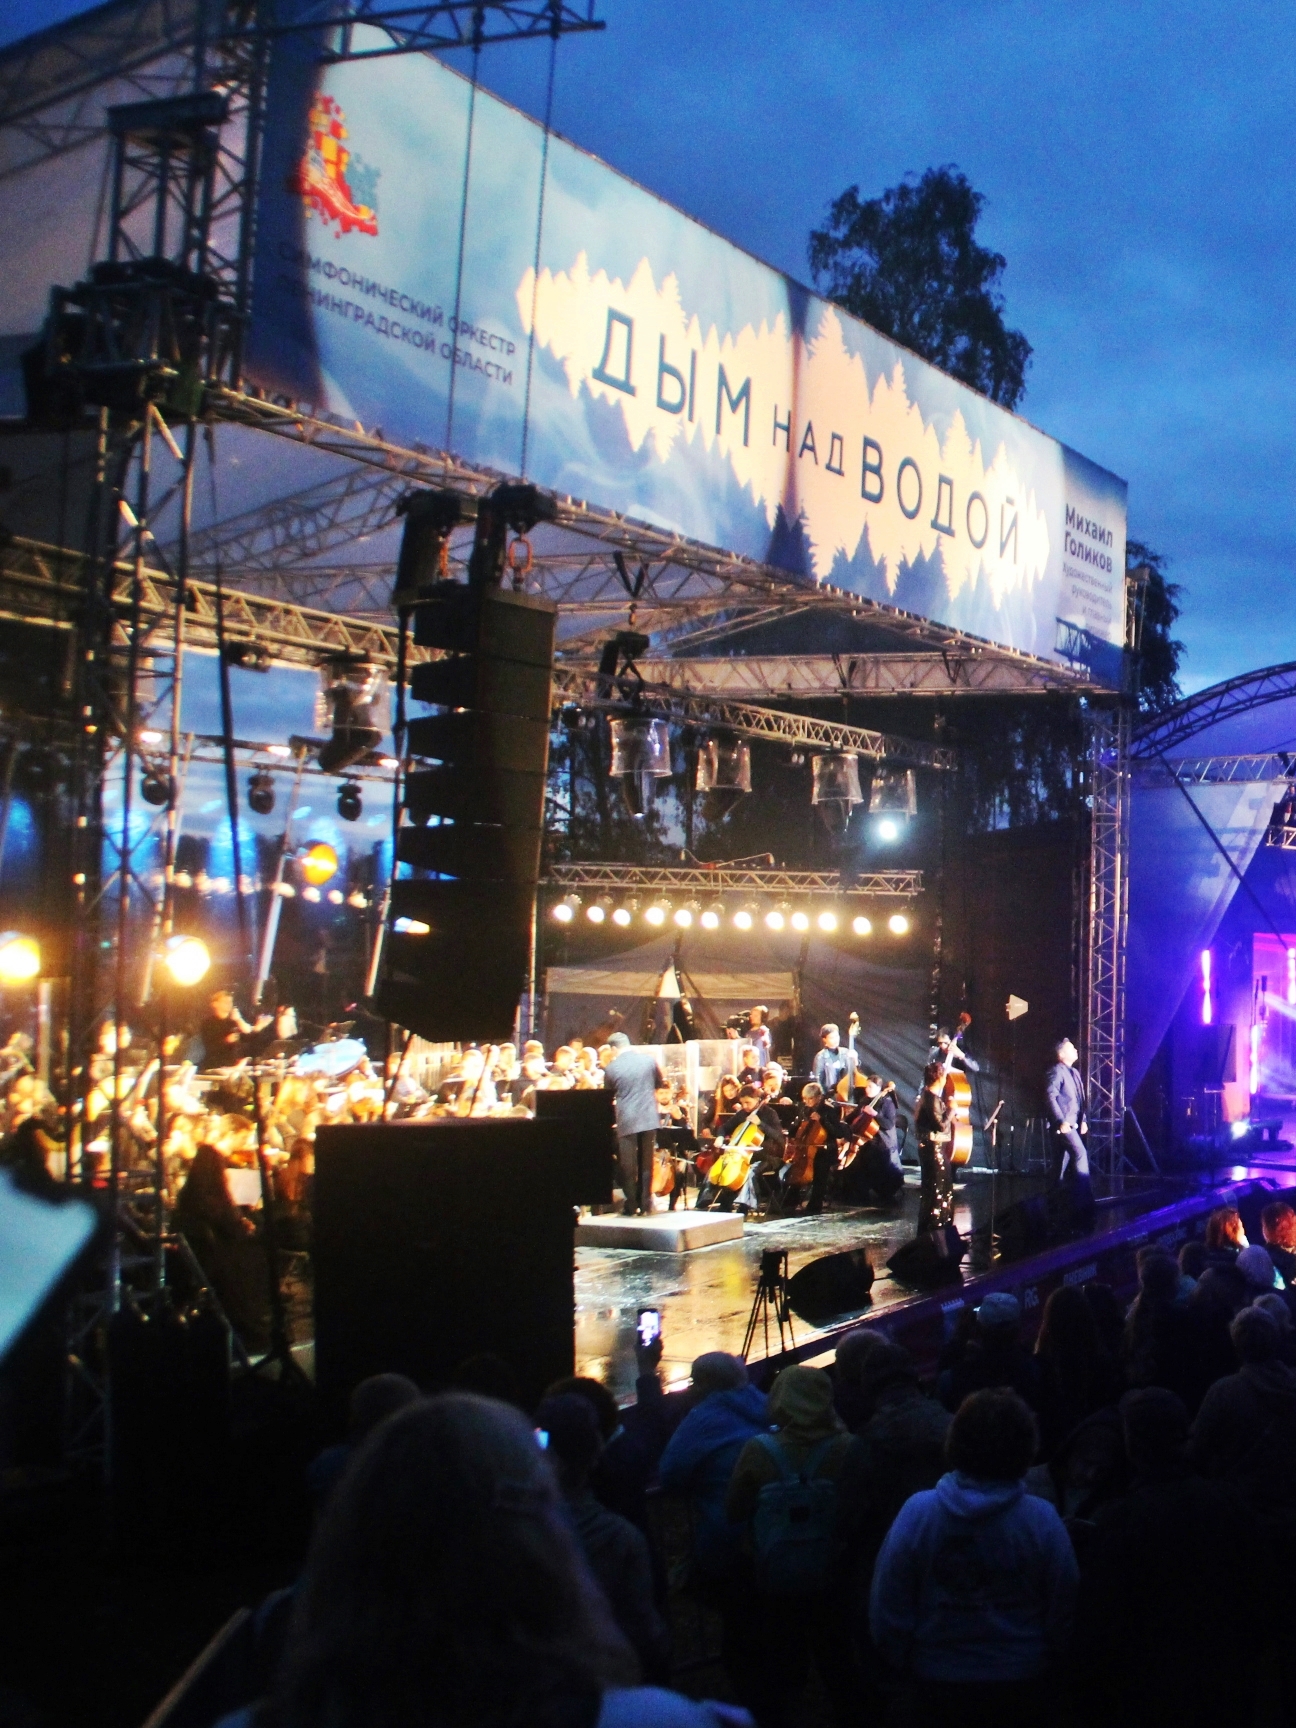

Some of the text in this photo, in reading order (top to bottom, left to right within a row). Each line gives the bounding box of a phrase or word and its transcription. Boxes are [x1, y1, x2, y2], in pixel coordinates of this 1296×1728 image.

[448, 315, 515, 356] ОРКЕСТР
[441, 343, 513, 386] ОБЛАСТИ
[592, 306, 1020, 565] ДЫМ НАД ВОДОЙ
[1065, 503, 1113, 549] Михаил
[1064, 530, 1113, 574] Голиков
